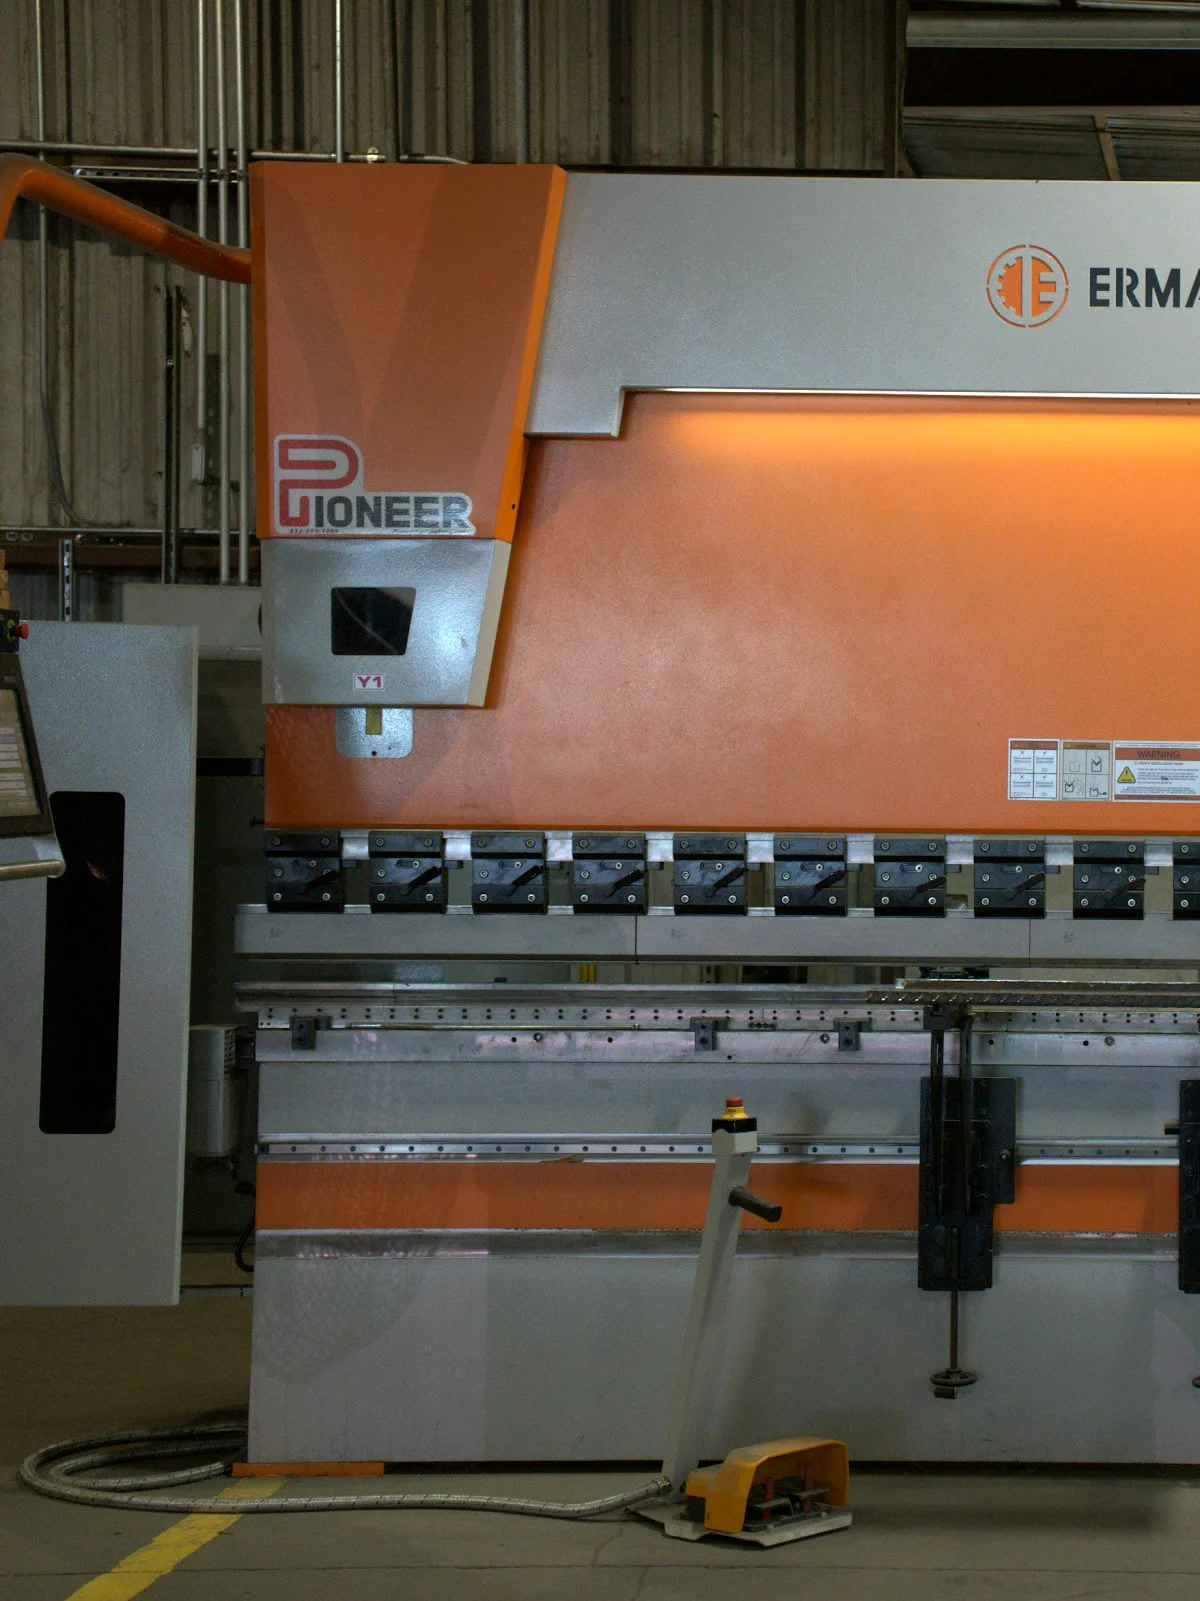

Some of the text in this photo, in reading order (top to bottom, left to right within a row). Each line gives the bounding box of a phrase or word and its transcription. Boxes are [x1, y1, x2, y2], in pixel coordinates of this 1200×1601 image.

[279, 439, 470, 528] PIONEER
[356, 675, 382, 688] Y1
[1137, 750, 1181, 759] WARNING
